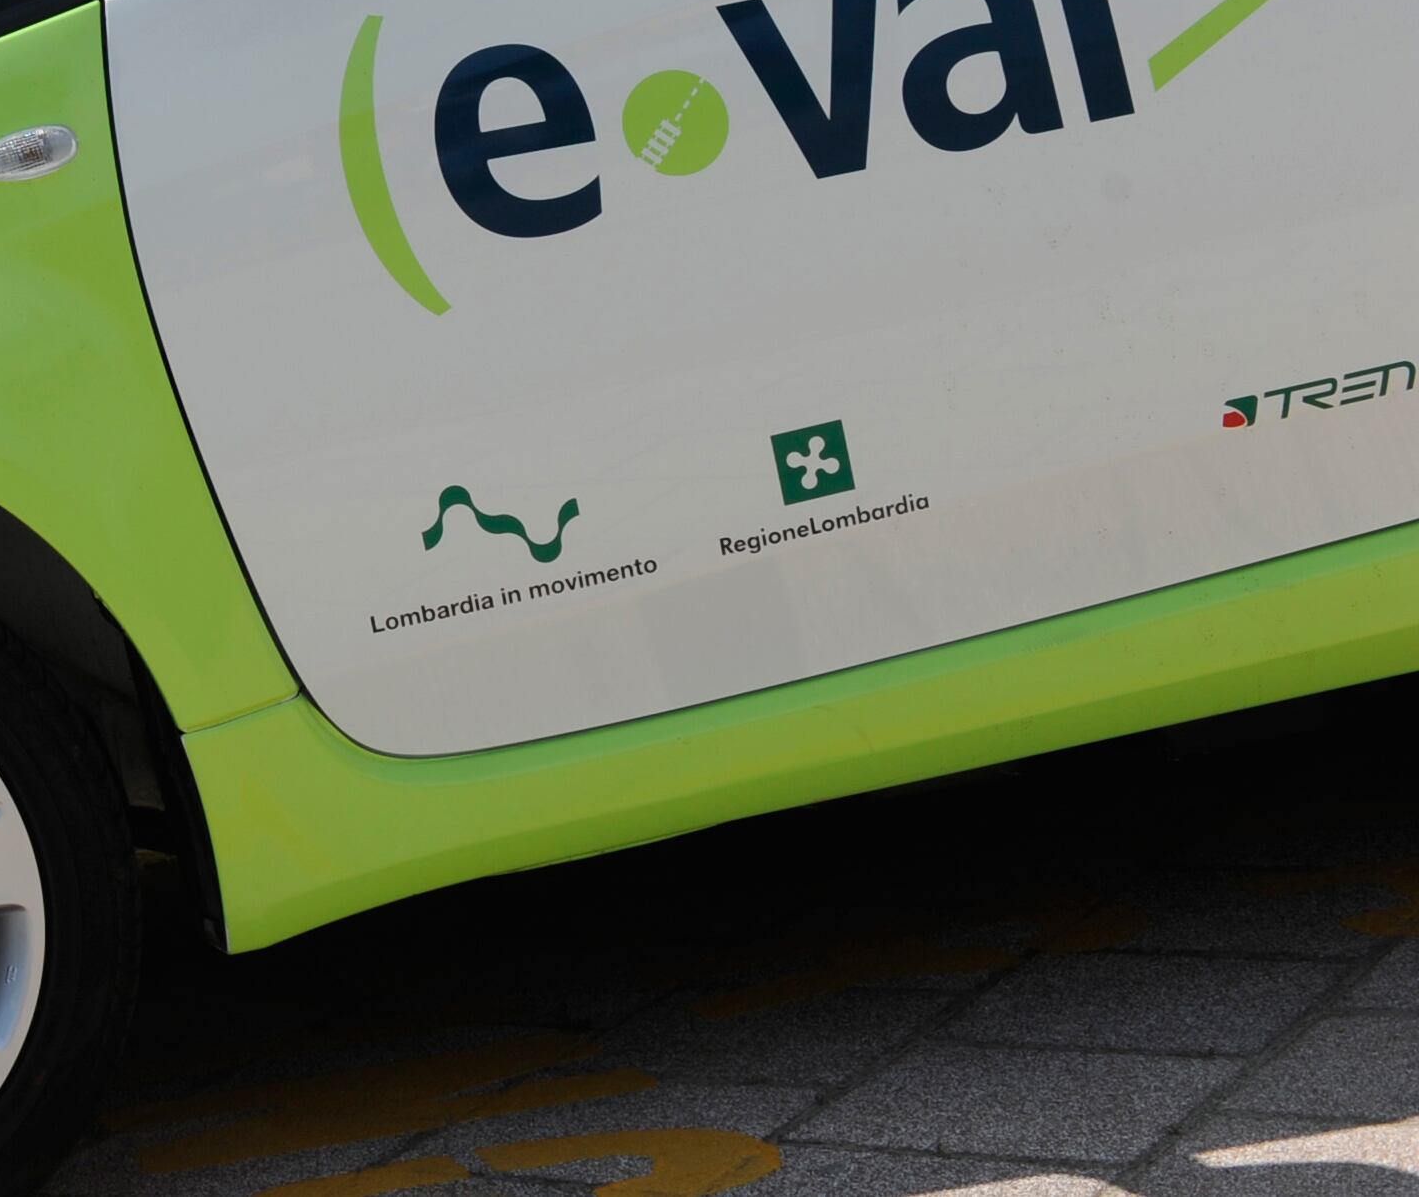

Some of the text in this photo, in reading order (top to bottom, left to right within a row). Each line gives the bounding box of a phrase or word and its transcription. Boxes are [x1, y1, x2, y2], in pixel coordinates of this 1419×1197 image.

[370, 558, 658, 633] Lombardia in movimento
